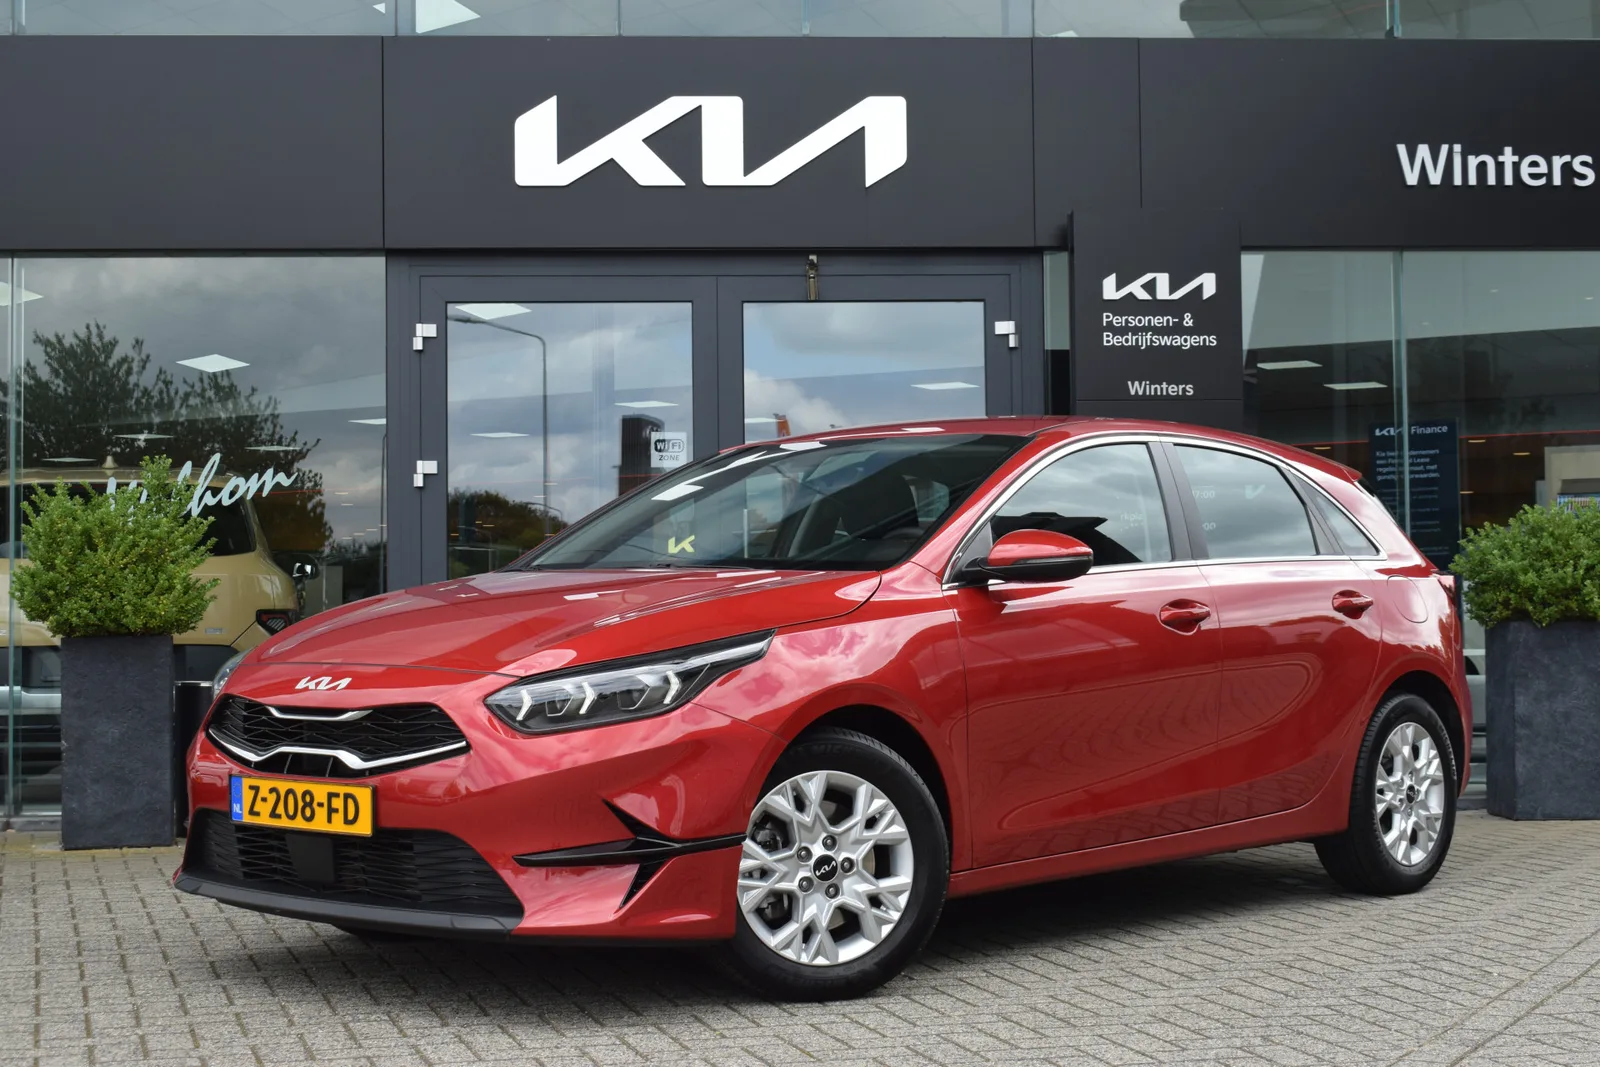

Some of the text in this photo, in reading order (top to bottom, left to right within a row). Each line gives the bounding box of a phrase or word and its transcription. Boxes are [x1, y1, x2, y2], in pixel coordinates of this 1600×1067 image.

[514, 95, 908, 188] KIA
[1396, 143, 1596, 188] Winters
[1102, 272, 1217, 301] KIA
[1102, 312, 1194, 327] Personen- &
[1102, 332, 1218, 350] Bedrijfswagens
[1127, 381, 1195, 396] Winters
[1410, 425, 1449, 435] Finance
[294, 676, 353, 691] KIA
[233, 784, 361, 826] NL Z-208-FD
[815, 860, 837, 876] KIA
